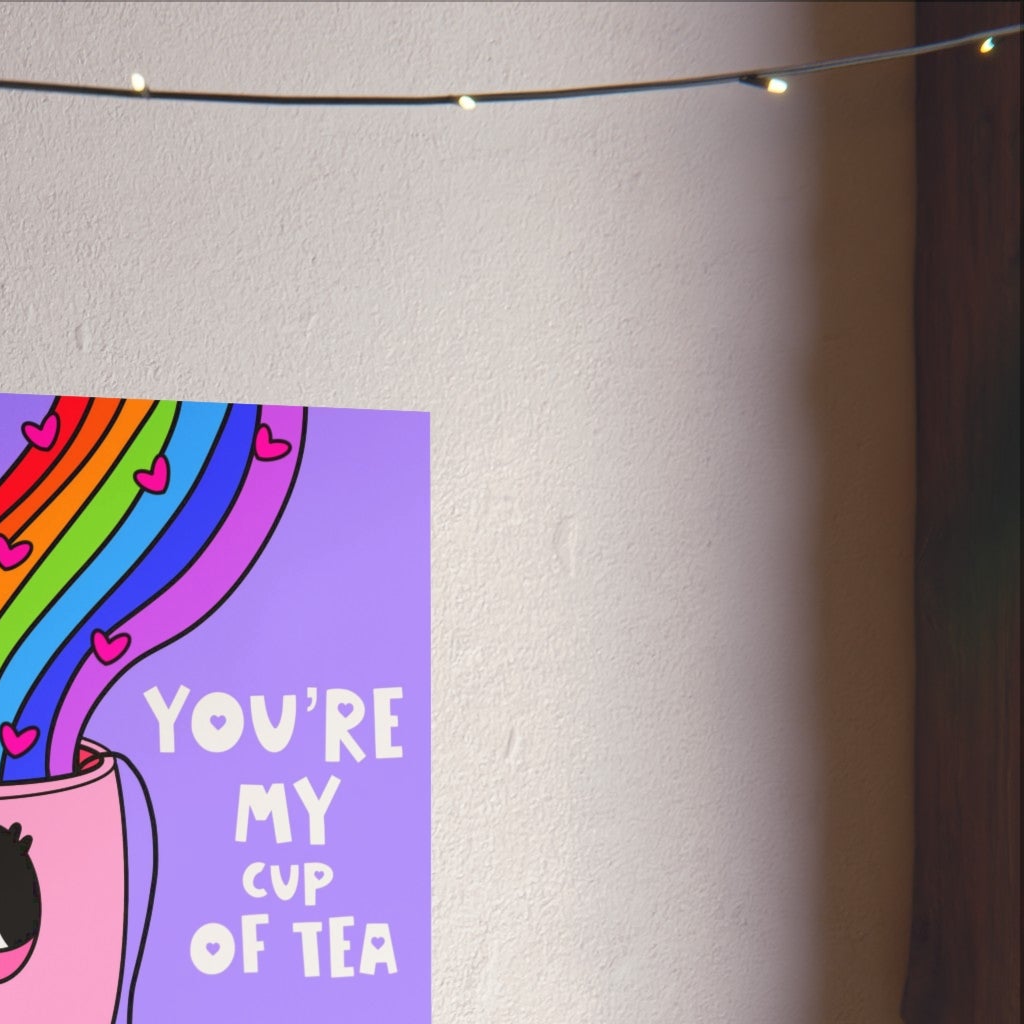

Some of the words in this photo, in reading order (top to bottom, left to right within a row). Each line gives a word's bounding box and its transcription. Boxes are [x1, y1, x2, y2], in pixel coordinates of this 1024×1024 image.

[143, 684, 404, 763] YOU’RE
[235, 775, 342, 846] MY
[242, 861, 334, 907] CUP
[190, 913, 270, 976] OF
[292, 915, 398, 979] TEA
